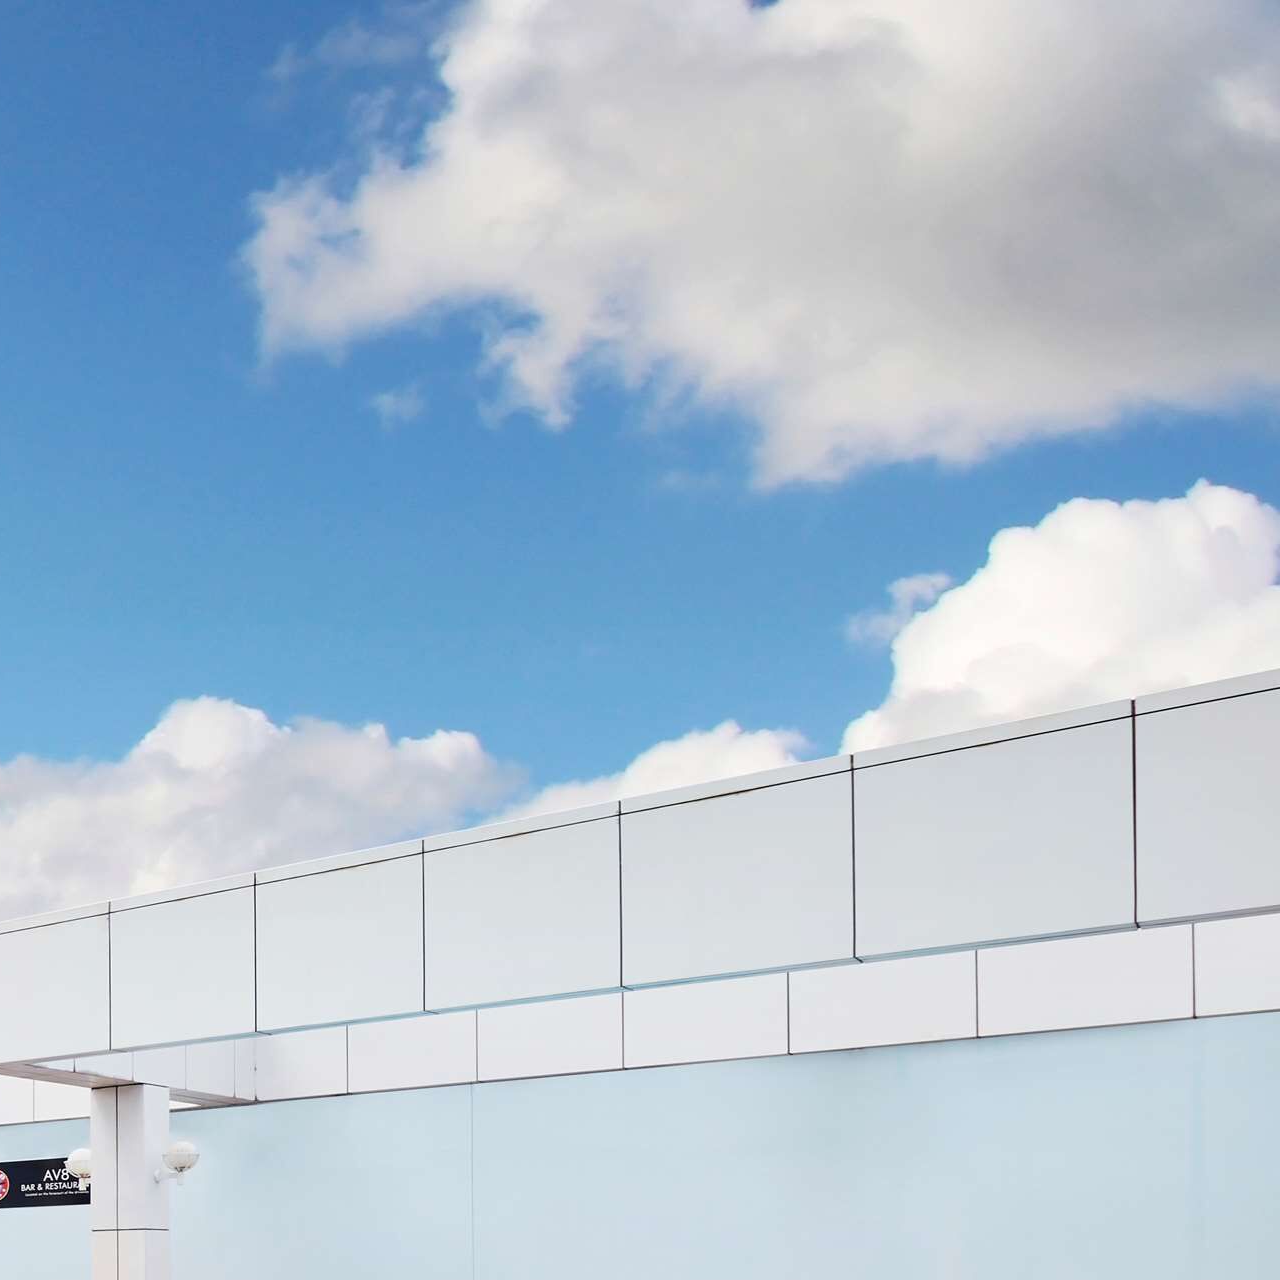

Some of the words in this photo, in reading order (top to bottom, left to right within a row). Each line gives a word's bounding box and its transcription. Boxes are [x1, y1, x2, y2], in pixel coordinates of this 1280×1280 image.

[43, 1168, 70, 1182] AV8
[21, 1183, 36, 1192] BAR
[37, 1183, 43, 1191] &
[45, 1181, 89, 1191] RESTAURA
